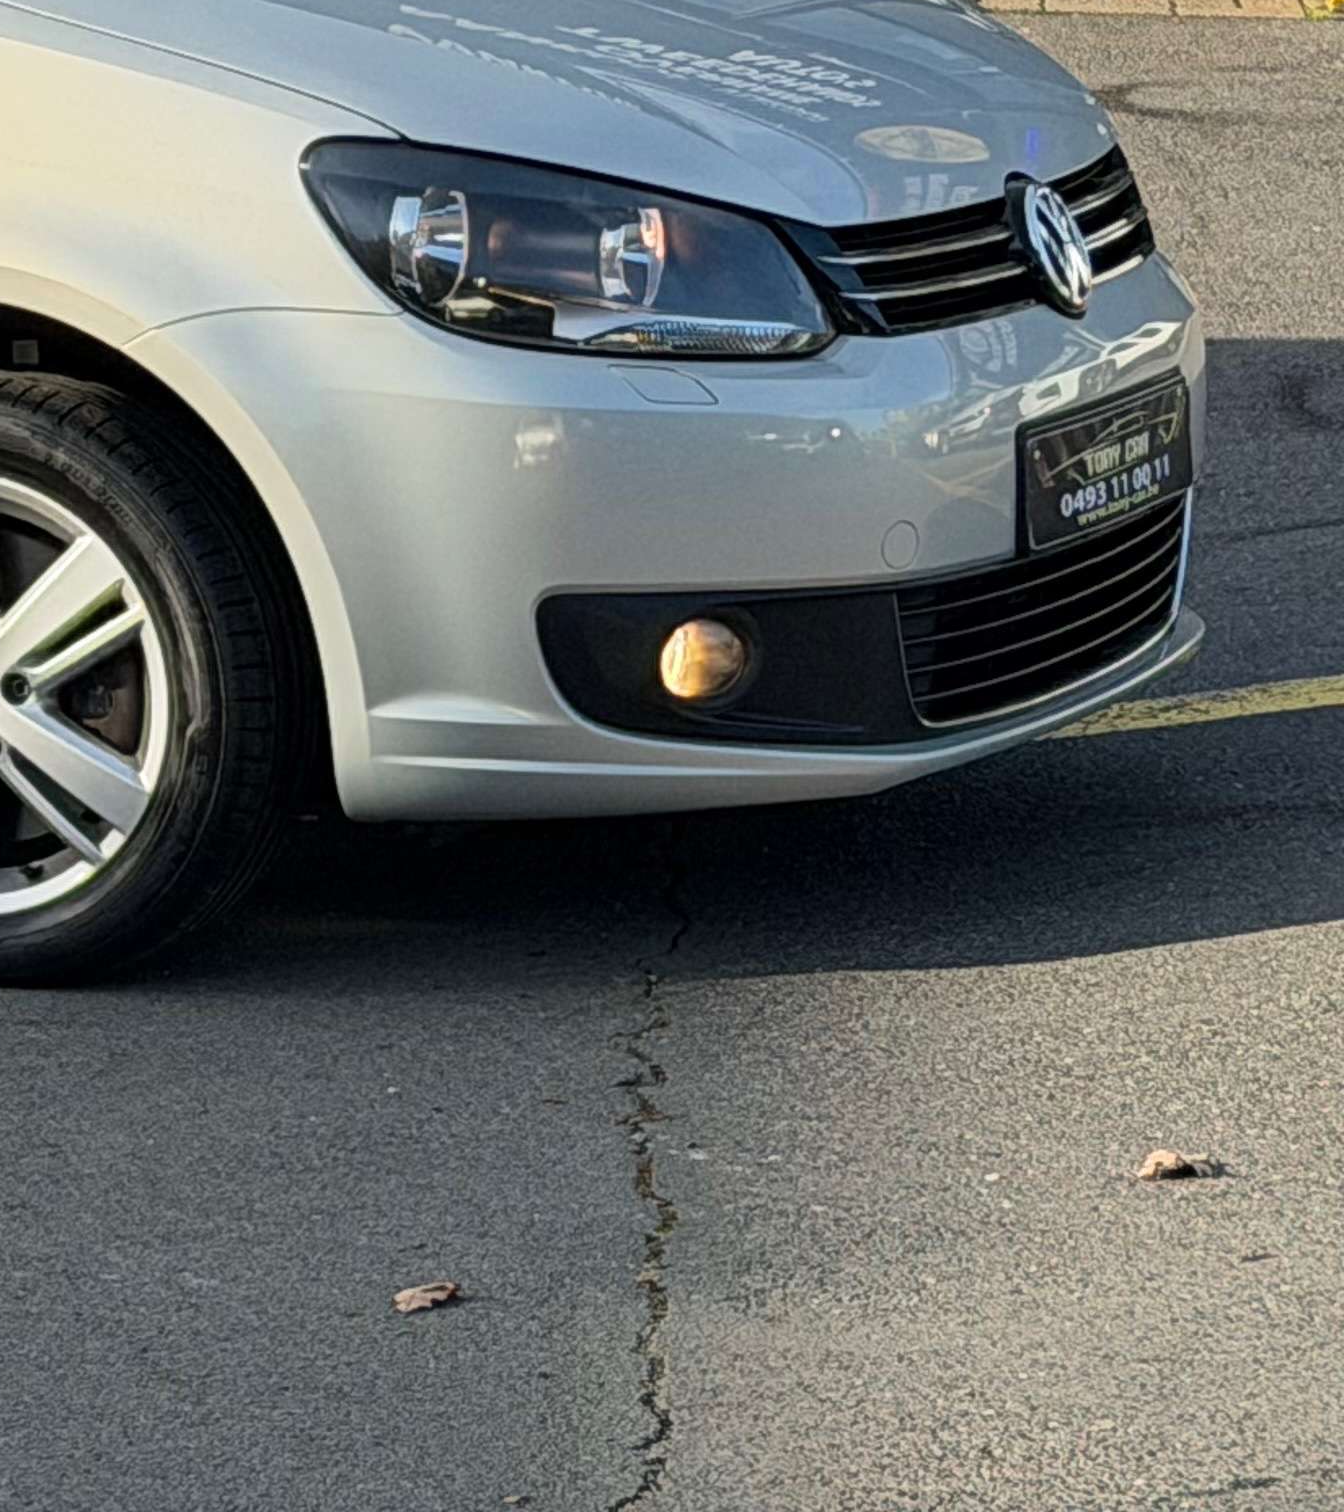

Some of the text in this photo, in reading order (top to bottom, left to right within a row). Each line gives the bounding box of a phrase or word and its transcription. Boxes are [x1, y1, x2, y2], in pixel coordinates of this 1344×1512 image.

[1060, 481, 1108, 518] 0493
[1110, 472, 1129, 498] 11
[1154, 453, 1171, 481] 11
